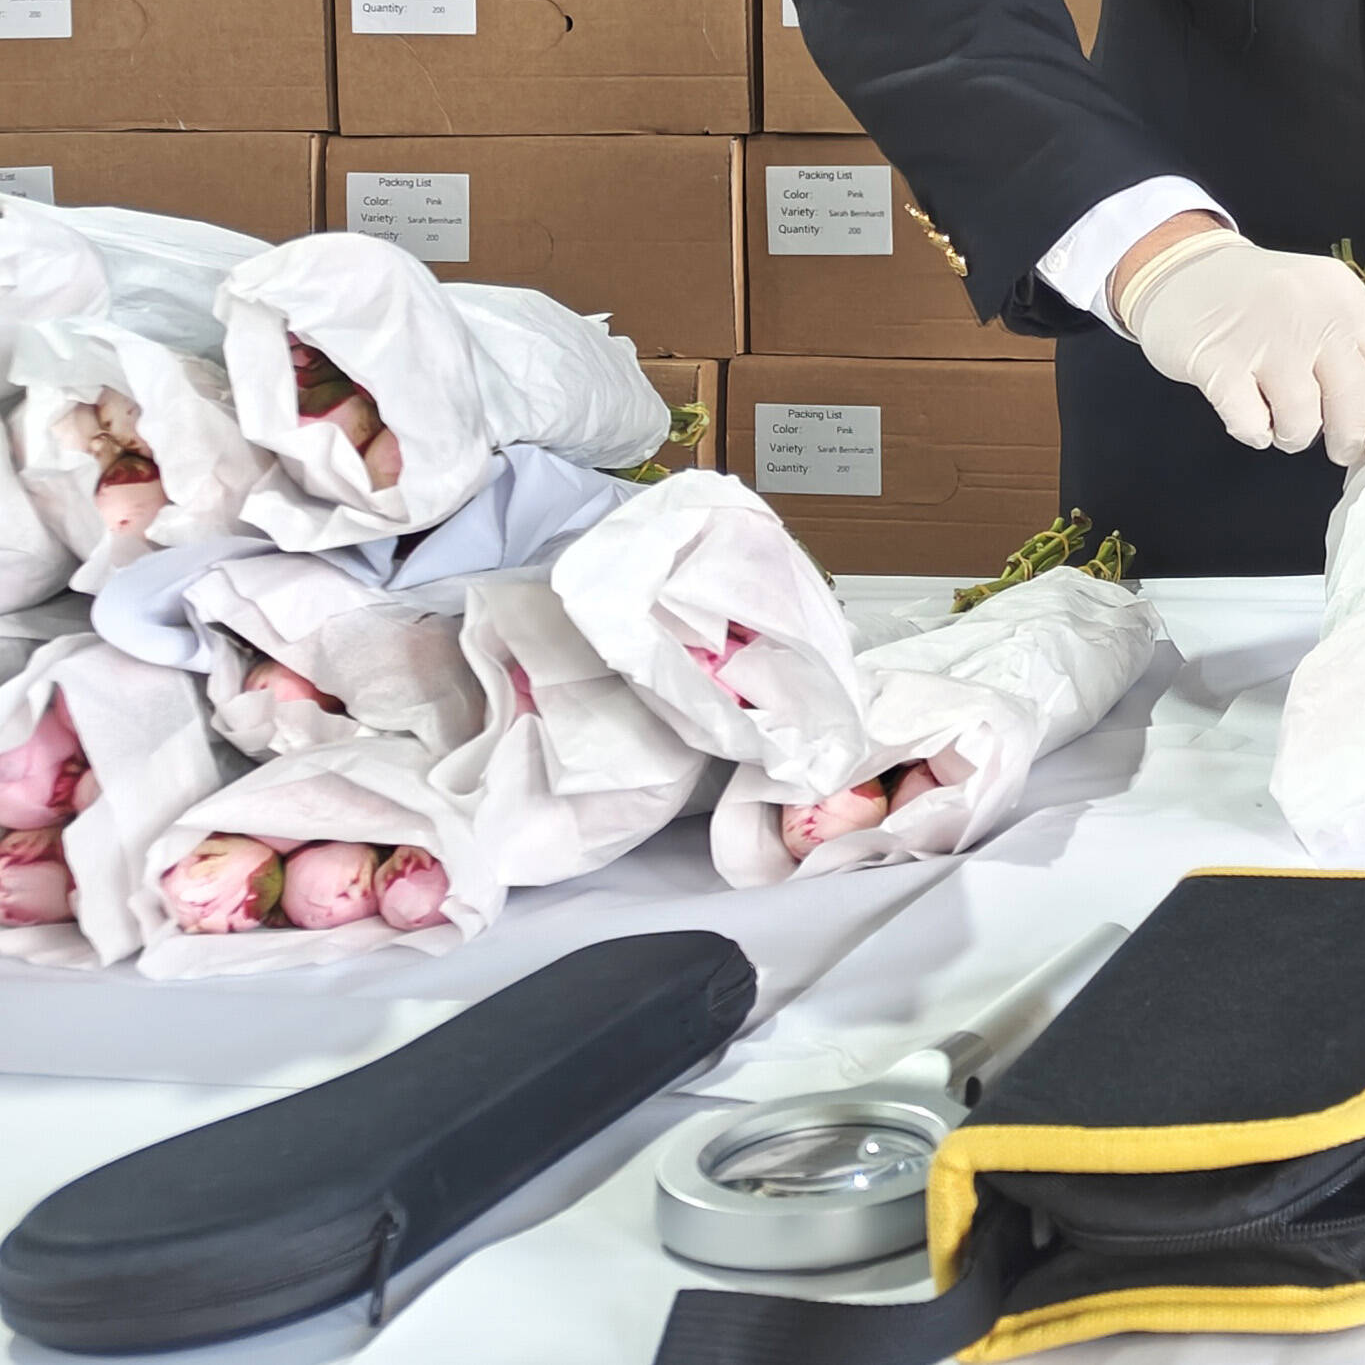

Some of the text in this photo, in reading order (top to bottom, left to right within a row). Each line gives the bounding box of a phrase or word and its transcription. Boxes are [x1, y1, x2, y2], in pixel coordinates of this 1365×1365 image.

[432, 6, 446, 14] 200
[798, 170, 852, 181] Packing List
[378, 177, 432, 189] Packing List
[847, 190, 864, 198] Pink
[426, 197, 442, 205] Pink
[848, 227, 861, 235] 200
[426, 234, 439, 242] 200
[787, 409, 842, 421] Packing List
[836, 426, 853, 434] Pink
[836, 465, 850, 473] 200
